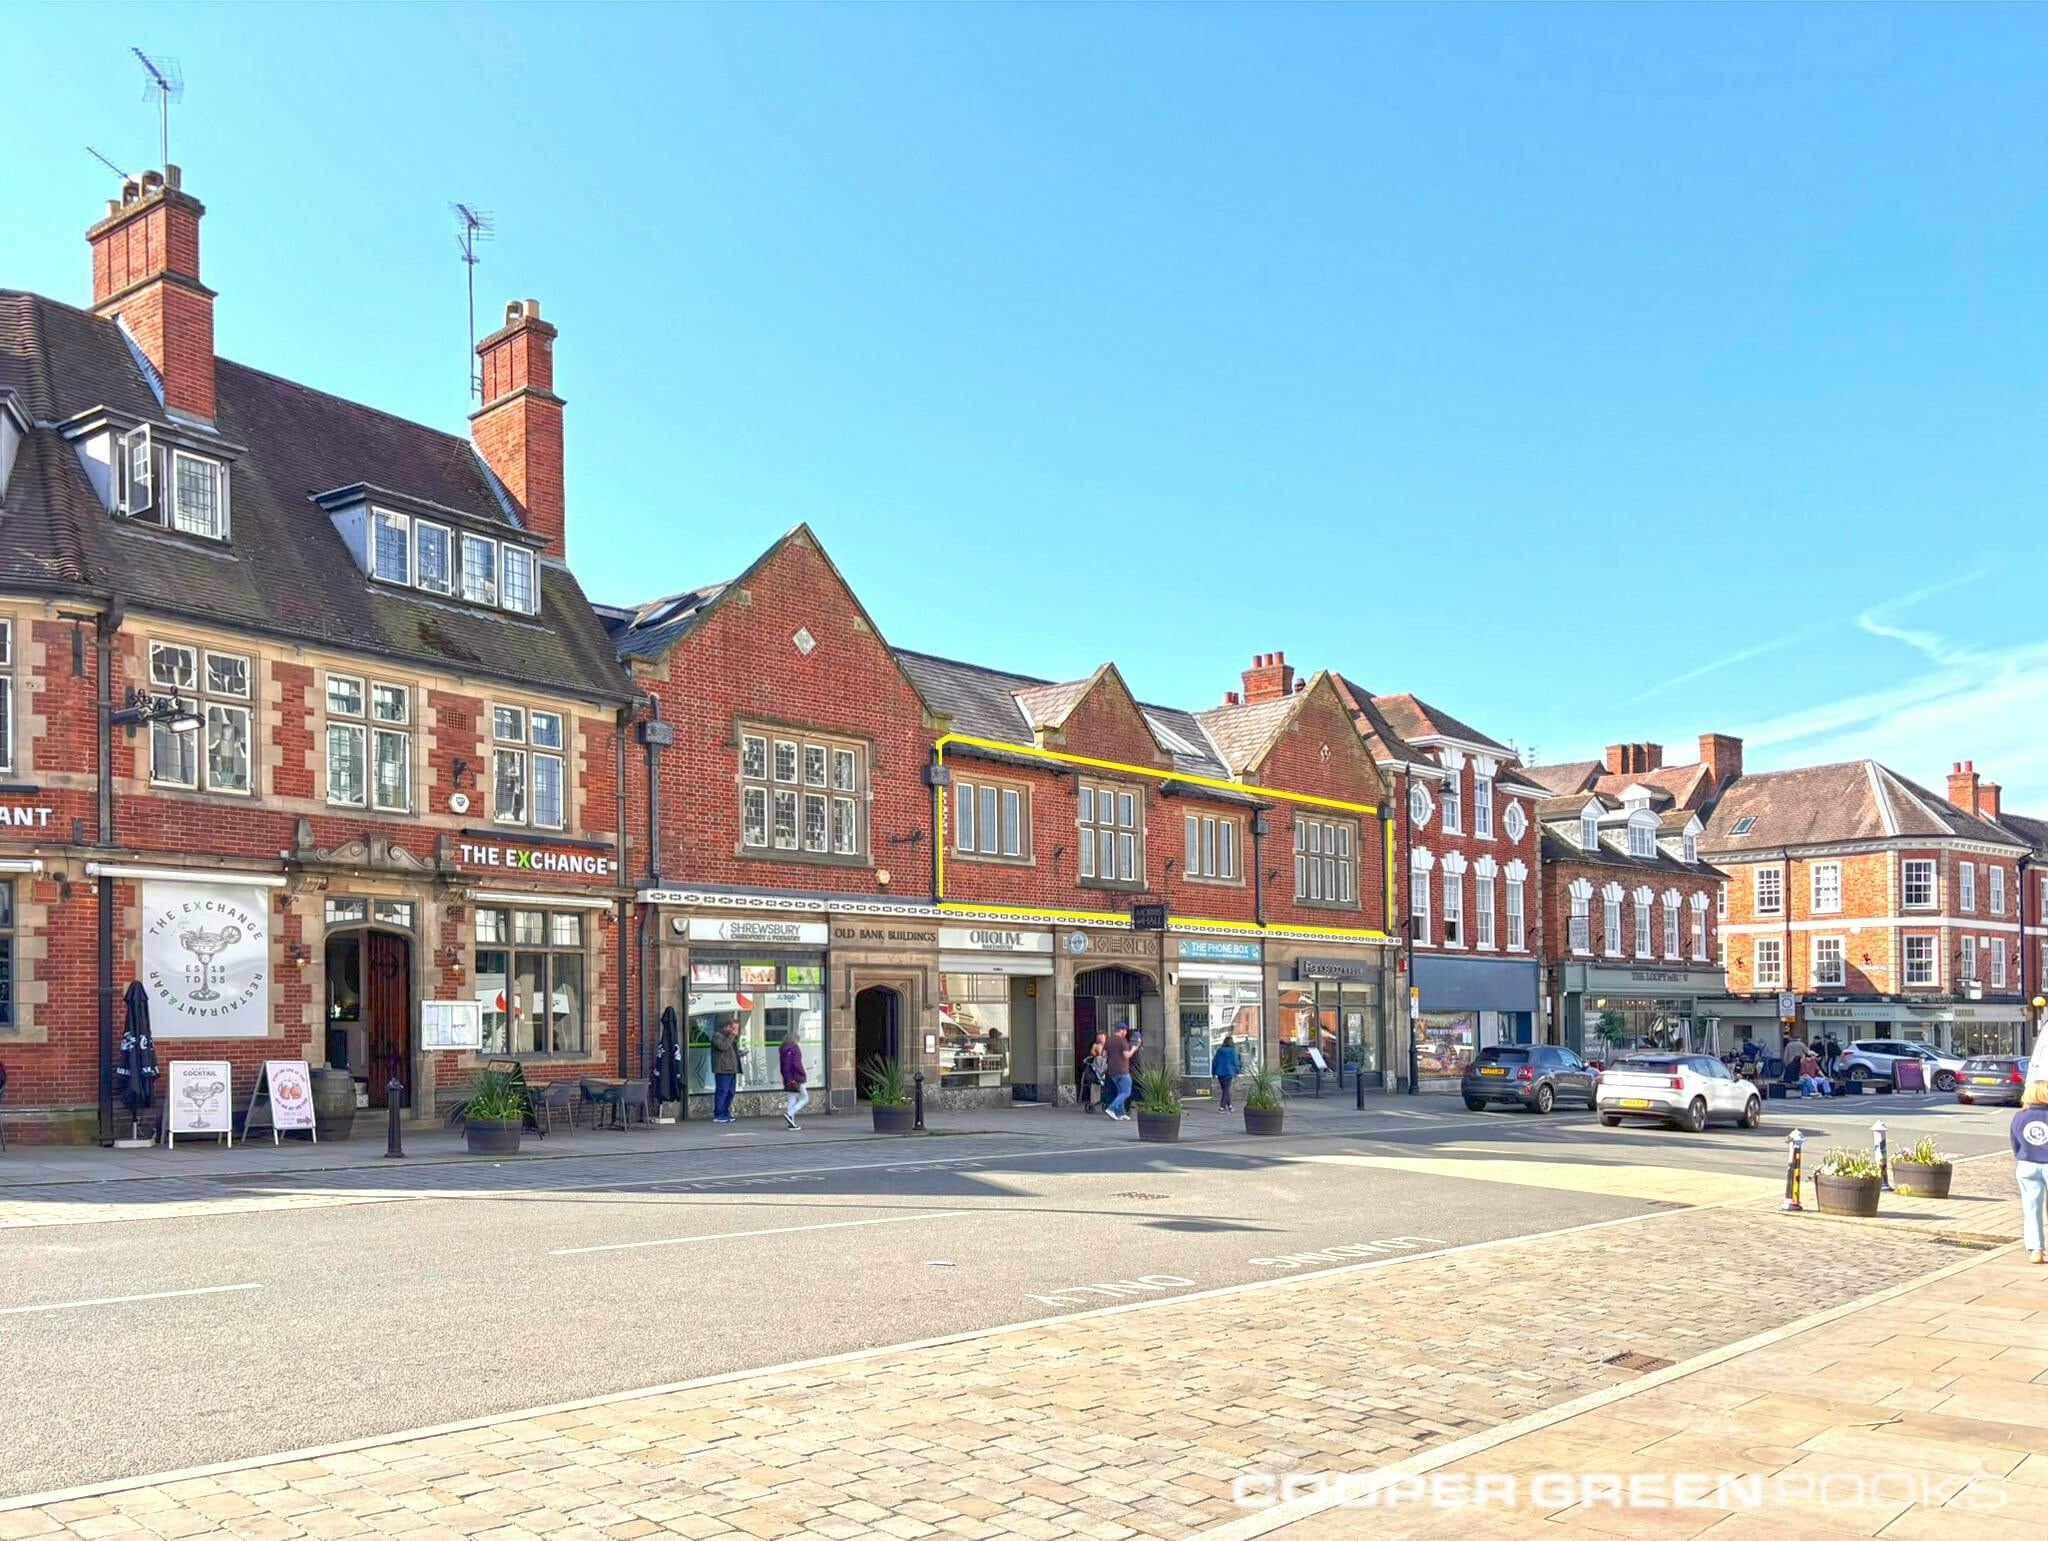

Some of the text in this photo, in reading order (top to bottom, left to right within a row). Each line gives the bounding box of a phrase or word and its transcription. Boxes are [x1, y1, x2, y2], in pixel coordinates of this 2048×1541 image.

[0, 806, 52, 826] ANT
[460, 844, 608, 875] THE EXCHANGE
[149, 901, 263, 941] THE EXCHANGE
[730, 922, 801, 935] SHREWSBURY
[834, 928, 936, 942] OLD BANK BUILDINGS
[1192, 942, 1249, 954] THE PHONE BOX
[177, 972, 263, 1017] RESTAURANT
[1811, 1008, 1853, 1017] WAKAKA
[1024, 1236, 1447, 1307] LOADING ONLY
